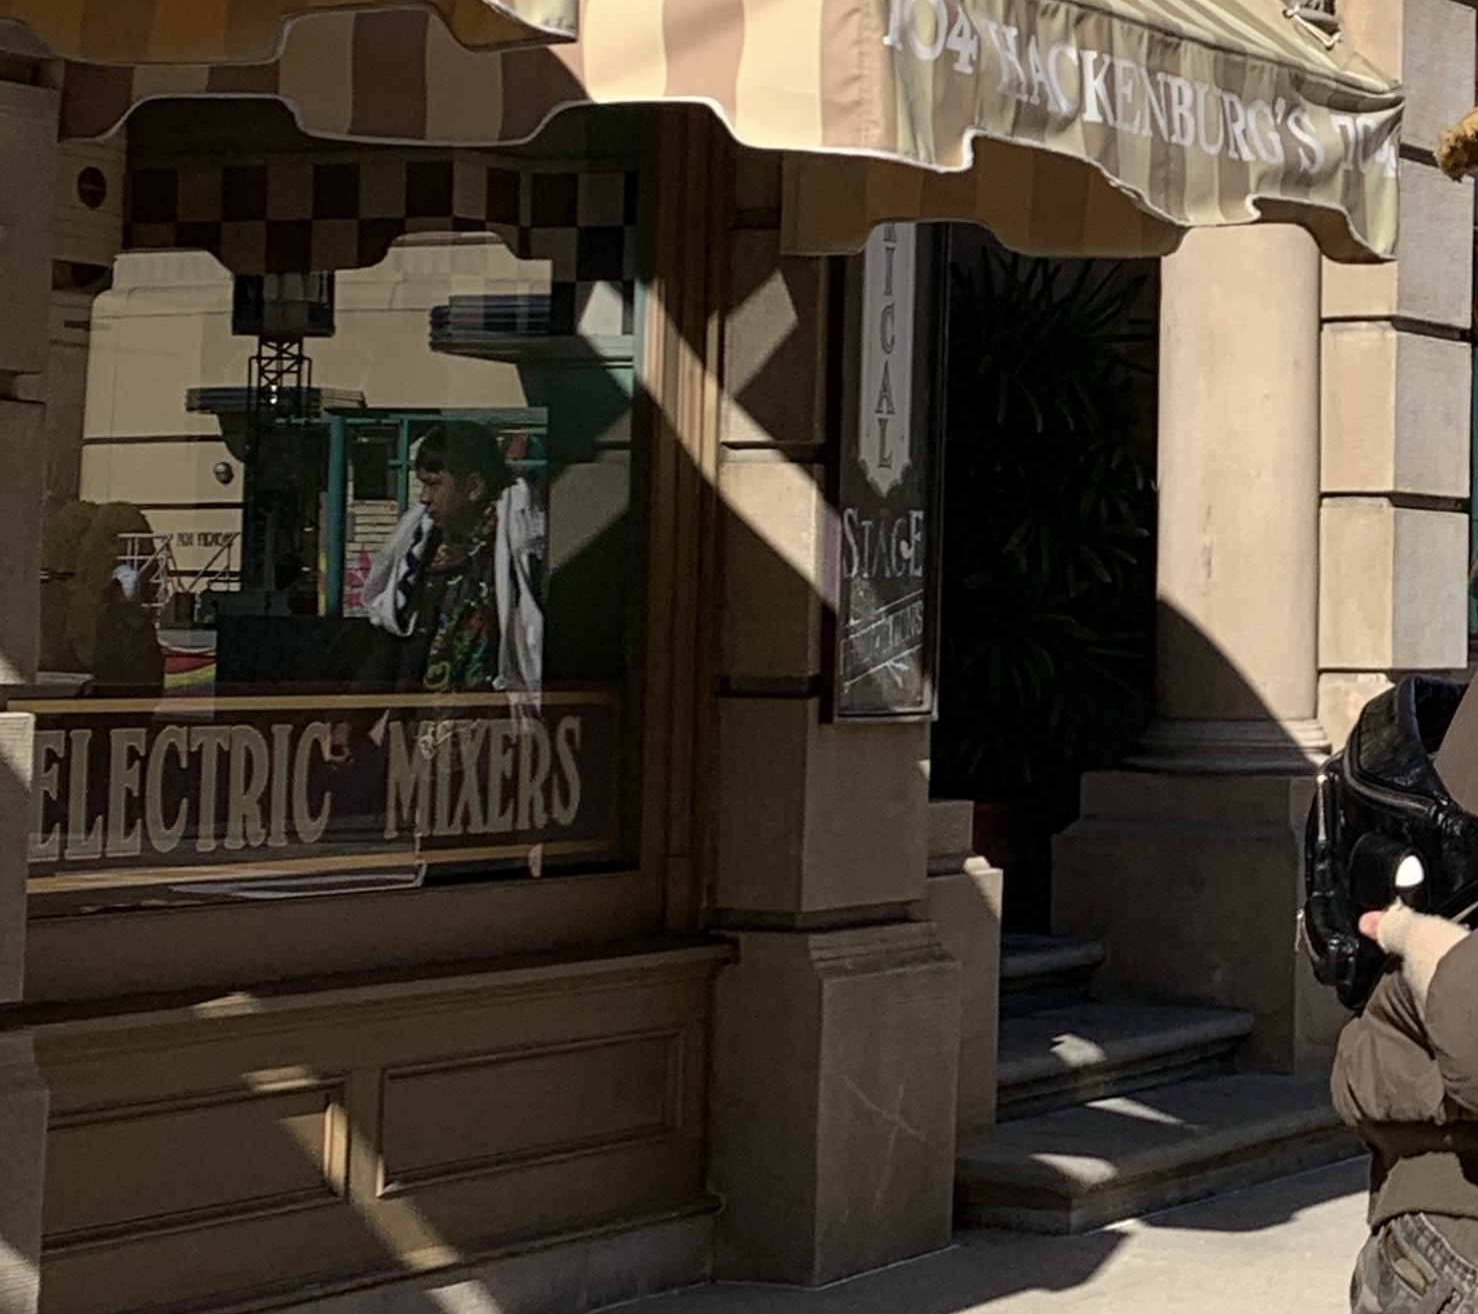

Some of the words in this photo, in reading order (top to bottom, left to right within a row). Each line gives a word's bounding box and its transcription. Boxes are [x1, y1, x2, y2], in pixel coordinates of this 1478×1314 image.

[842, 507, 924, 579] STAGE
[27, 721, 333, 864] ELECTRIC
[383, 716, 582, 840] MIXERS
